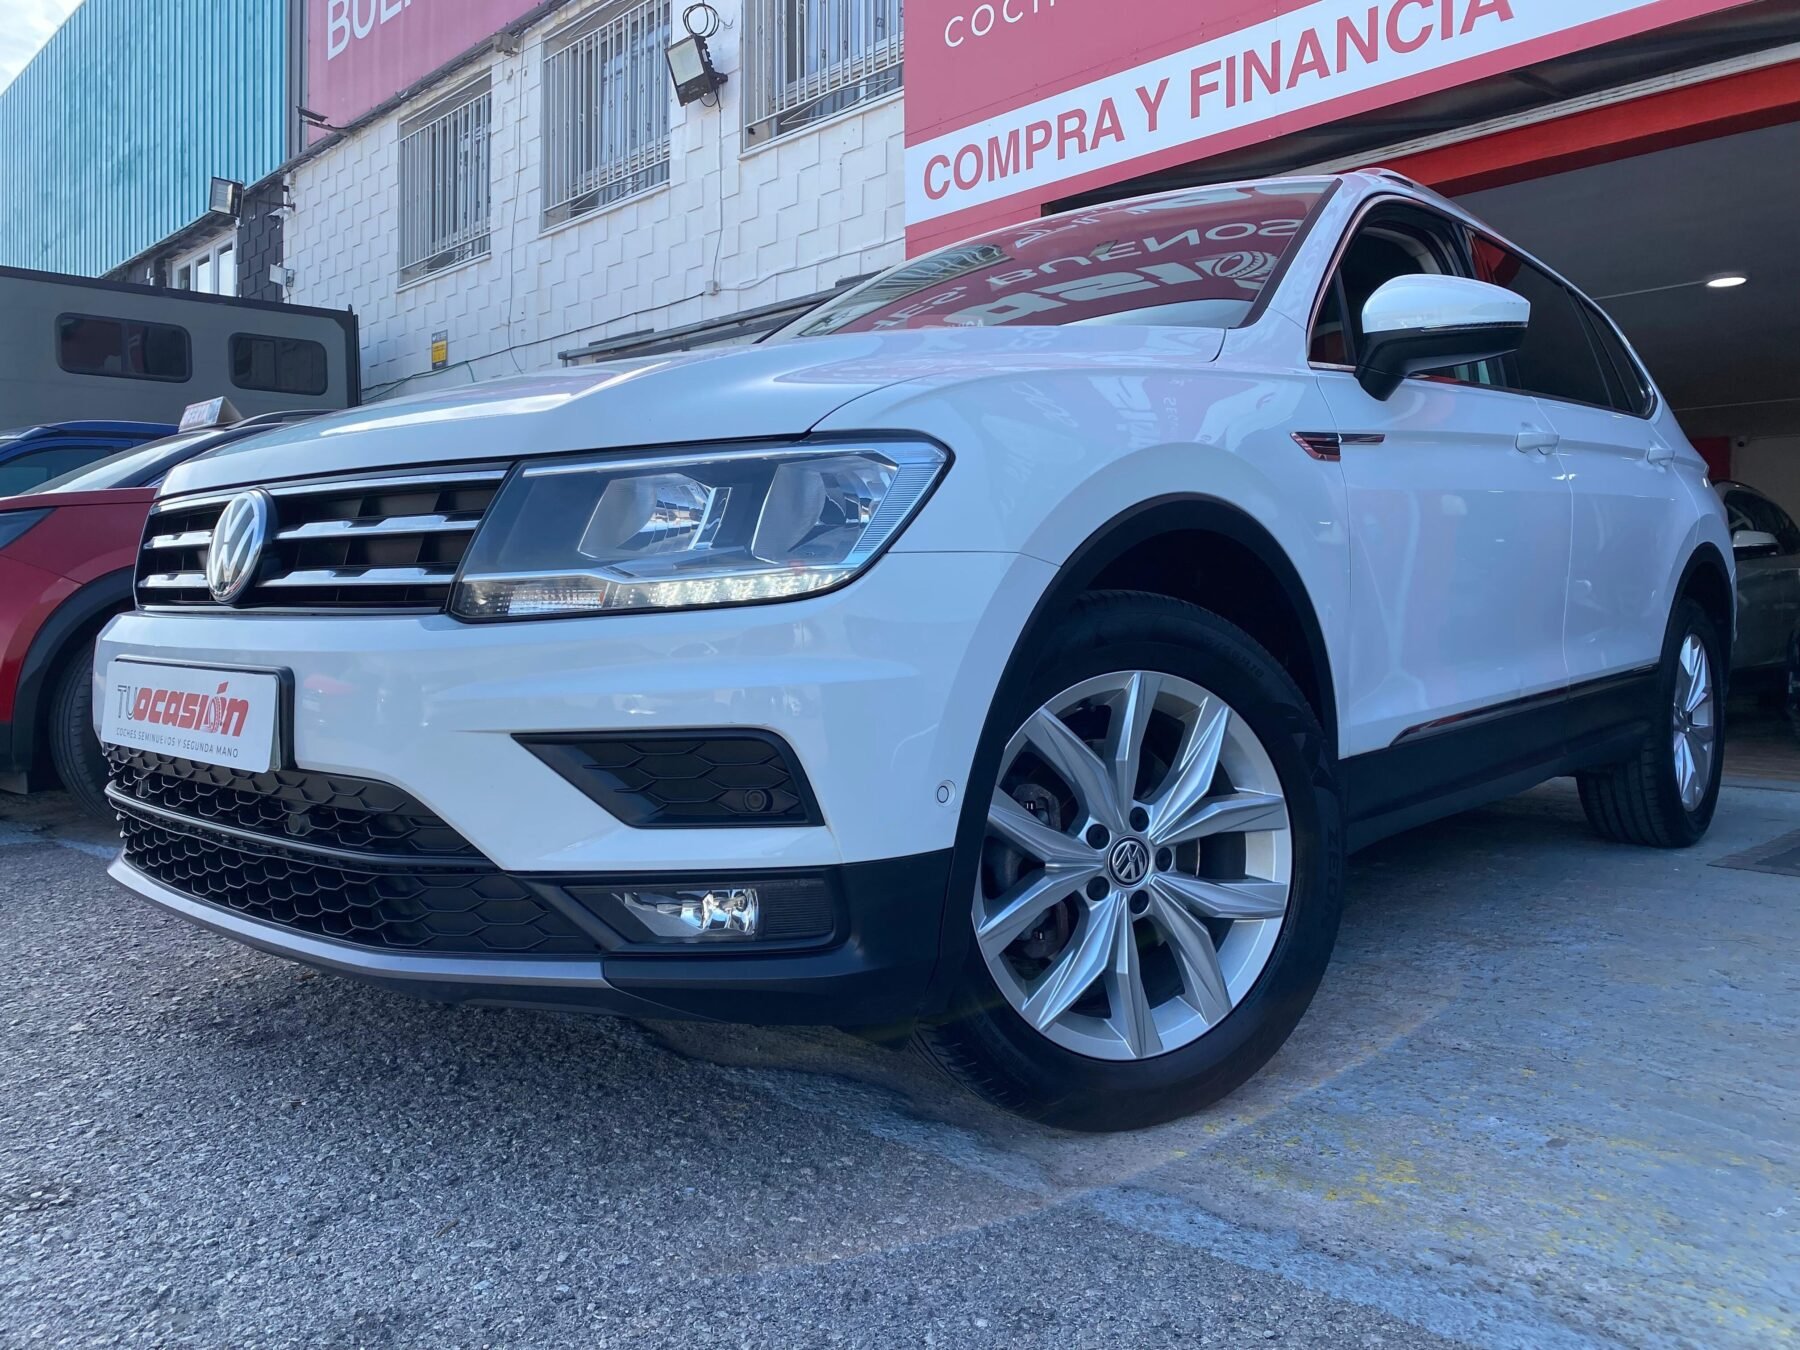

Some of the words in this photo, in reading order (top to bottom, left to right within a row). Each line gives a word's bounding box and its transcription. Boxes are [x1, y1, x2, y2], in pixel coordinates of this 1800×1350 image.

[944, 0, 1055, 48] COC
[924, 97, 1125, 200] COMPRA
[1135, 77, 1170, 133] Y
[1190, 0, 1515, 119] FINANCIA
[116, 727, 137, 739] COCHES
[138, 731, 175, 747] SEMINUEVOS
[183, 739, 214, 752] SEGUNDA
[216, 745, 239, 758] MANO
